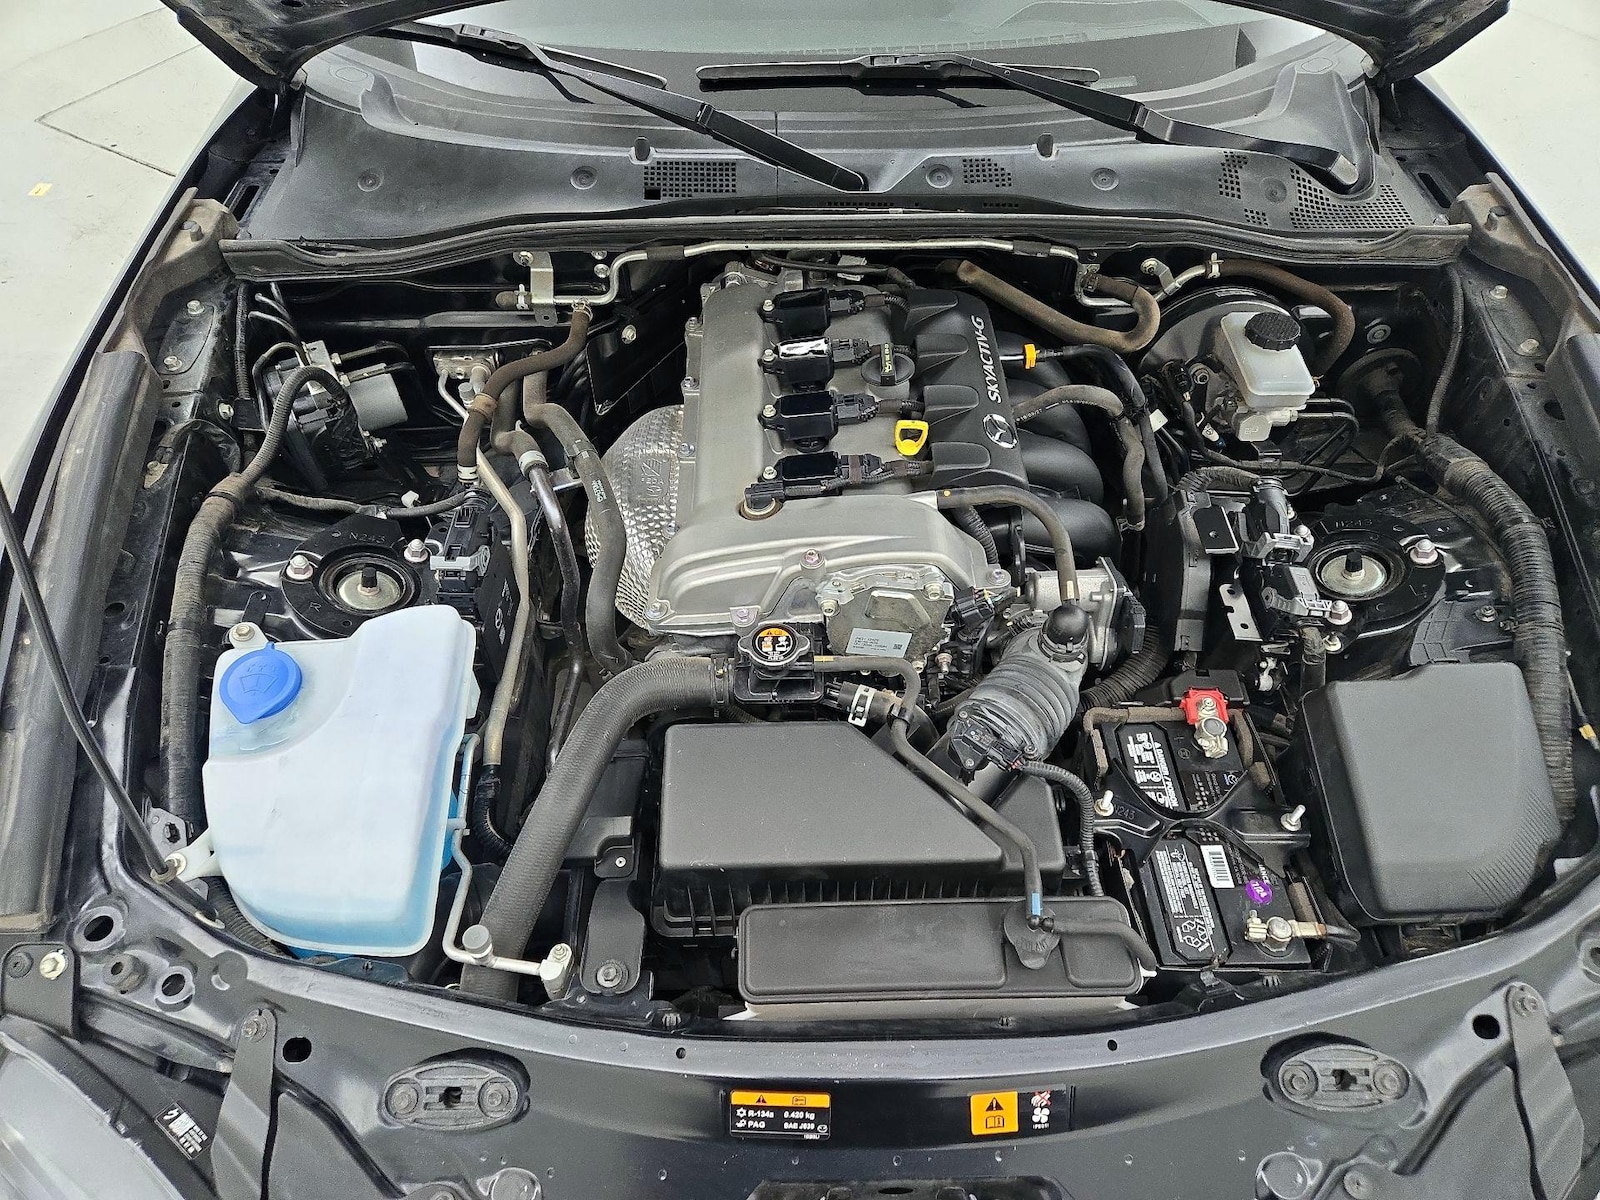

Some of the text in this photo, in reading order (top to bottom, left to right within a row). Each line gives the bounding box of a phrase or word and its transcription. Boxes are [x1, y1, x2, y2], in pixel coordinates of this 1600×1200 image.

[971, 315, 1002, 404] SKYACTIV-G
[1156, 748, 1168, 775] DANGER
[1164, 781, 1178, 807] POISON
[747, 1110, 815, 1120] R-134a 0.420 kg
